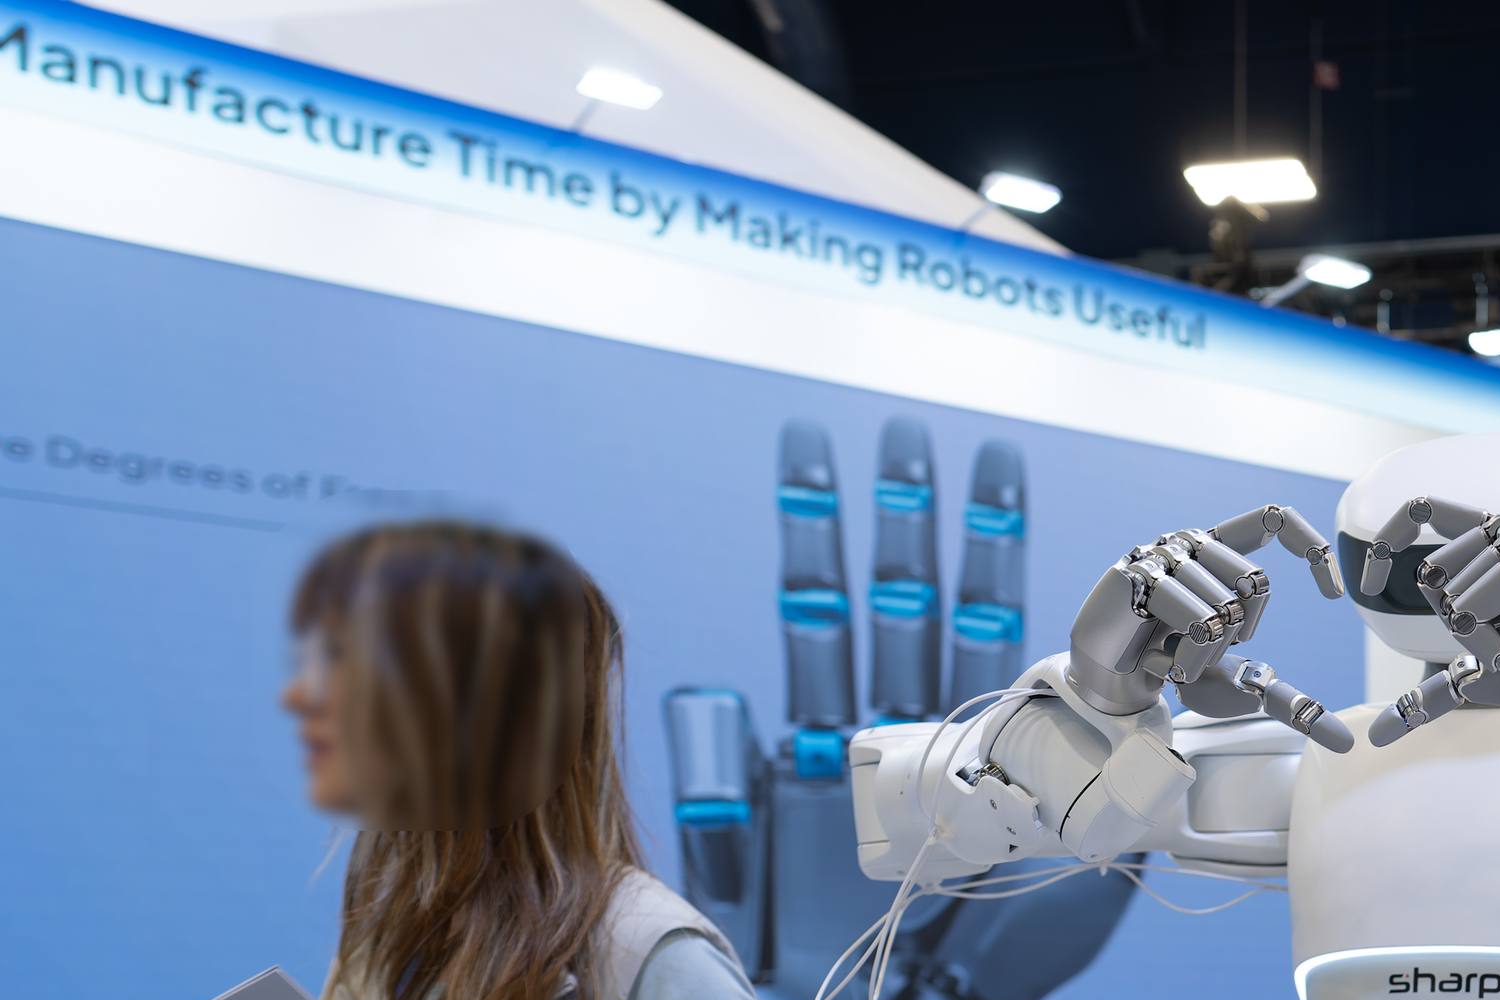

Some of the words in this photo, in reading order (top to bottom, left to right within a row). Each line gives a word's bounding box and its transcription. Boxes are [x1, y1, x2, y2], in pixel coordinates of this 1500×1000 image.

[449, 128, 594, 207] Time
[608, 170, 680, 238] by
[697, 193, 884, 286] Making
[898, 242, 1063, 316] Robots
[1073, 285, 1207, 350] Useful
[45, 434, 255, 494] Degrees
[261, 471, 310, 500] of
